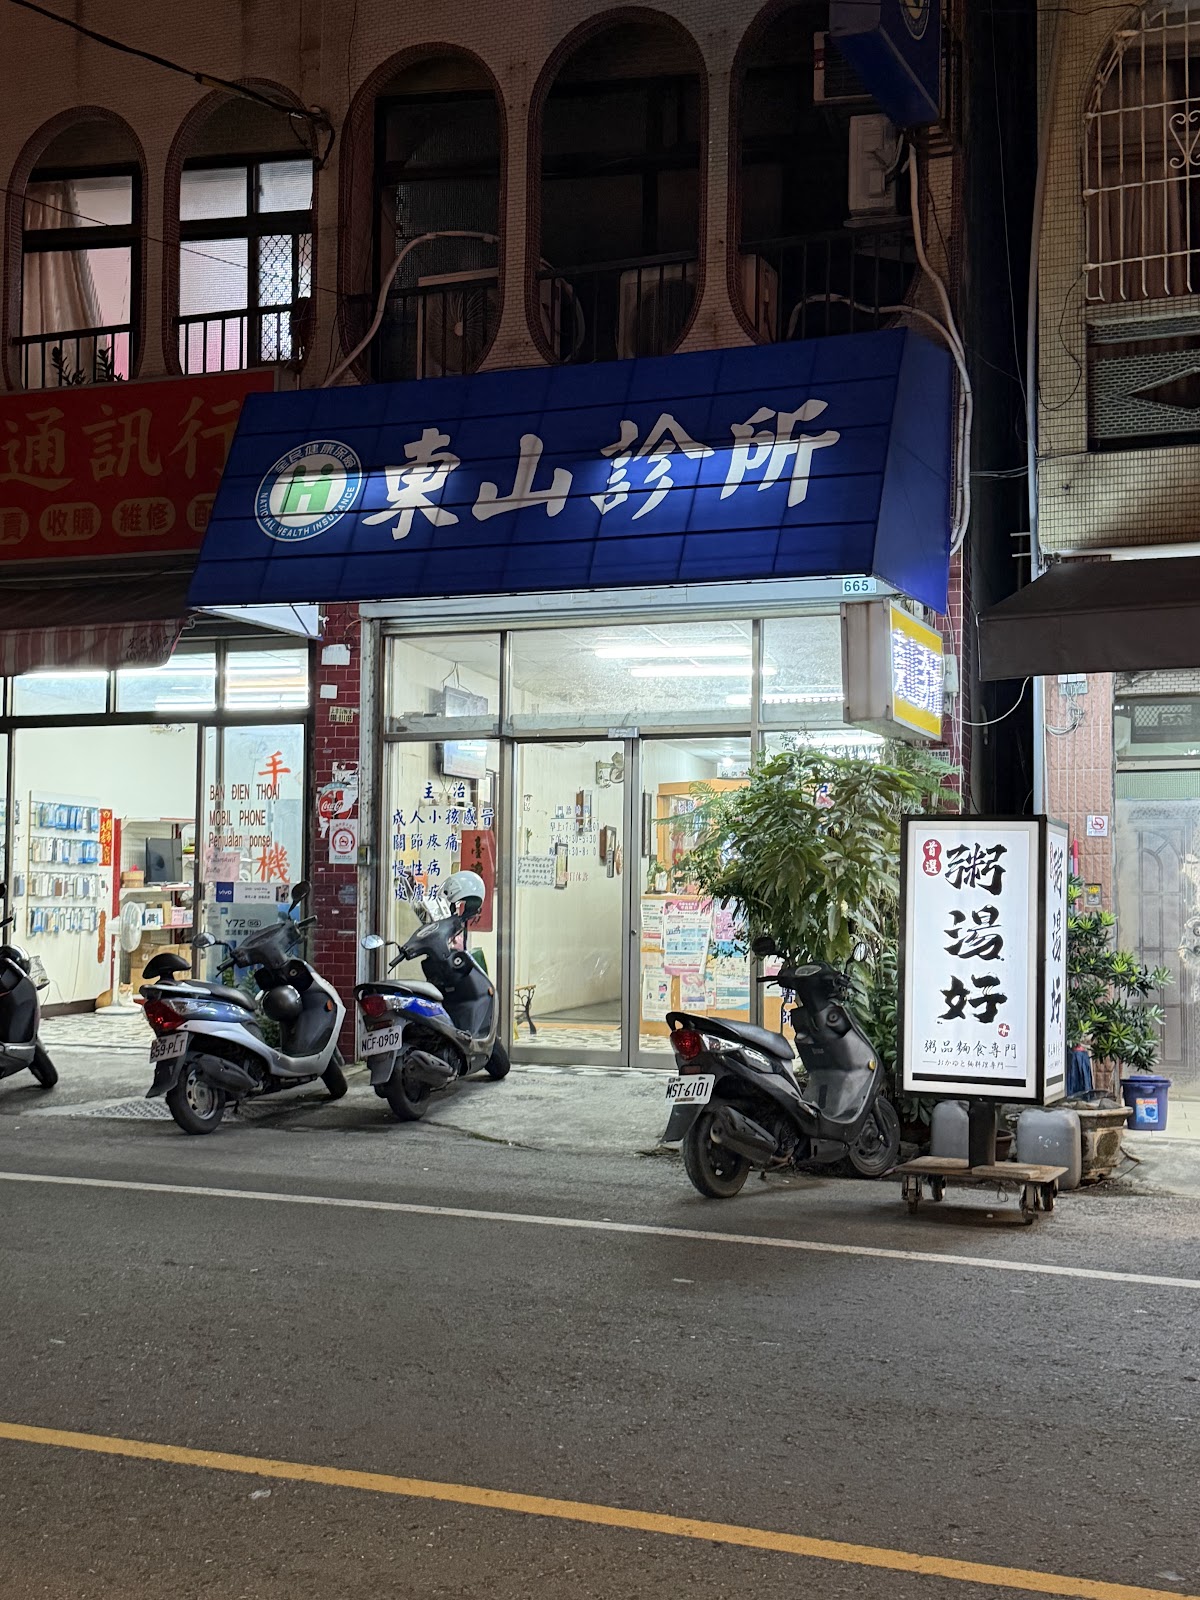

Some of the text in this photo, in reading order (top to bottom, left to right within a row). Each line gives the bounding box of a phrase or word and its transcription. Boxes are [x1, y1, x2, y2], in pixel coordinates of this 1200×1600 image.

[0, 396, 240, 491] 通訊行
[362, 399, 840, 540] 東山診所
[259, 486, 355, 537] NATIONAL HEALTH INSURANCE
[47, 506, 95, 537] 收購
[844, 580, 869, 592] 665
[423, 781, 466, 800] 主治
[209, 809, 266, 826] MOBIL PHONE
[392, 808, 495, 827] 成人小孩感冒
[393, 833, 458, 851] 關節疼痛
[925, 841, 938, 874] 首選
[392, 859, 441, 877] 慢性病
[225, 919, 246, 928] Y72
[937, 842, 1008, 1024] 粥湯好
[361, 1032, 399, 1052] NCF-0909
